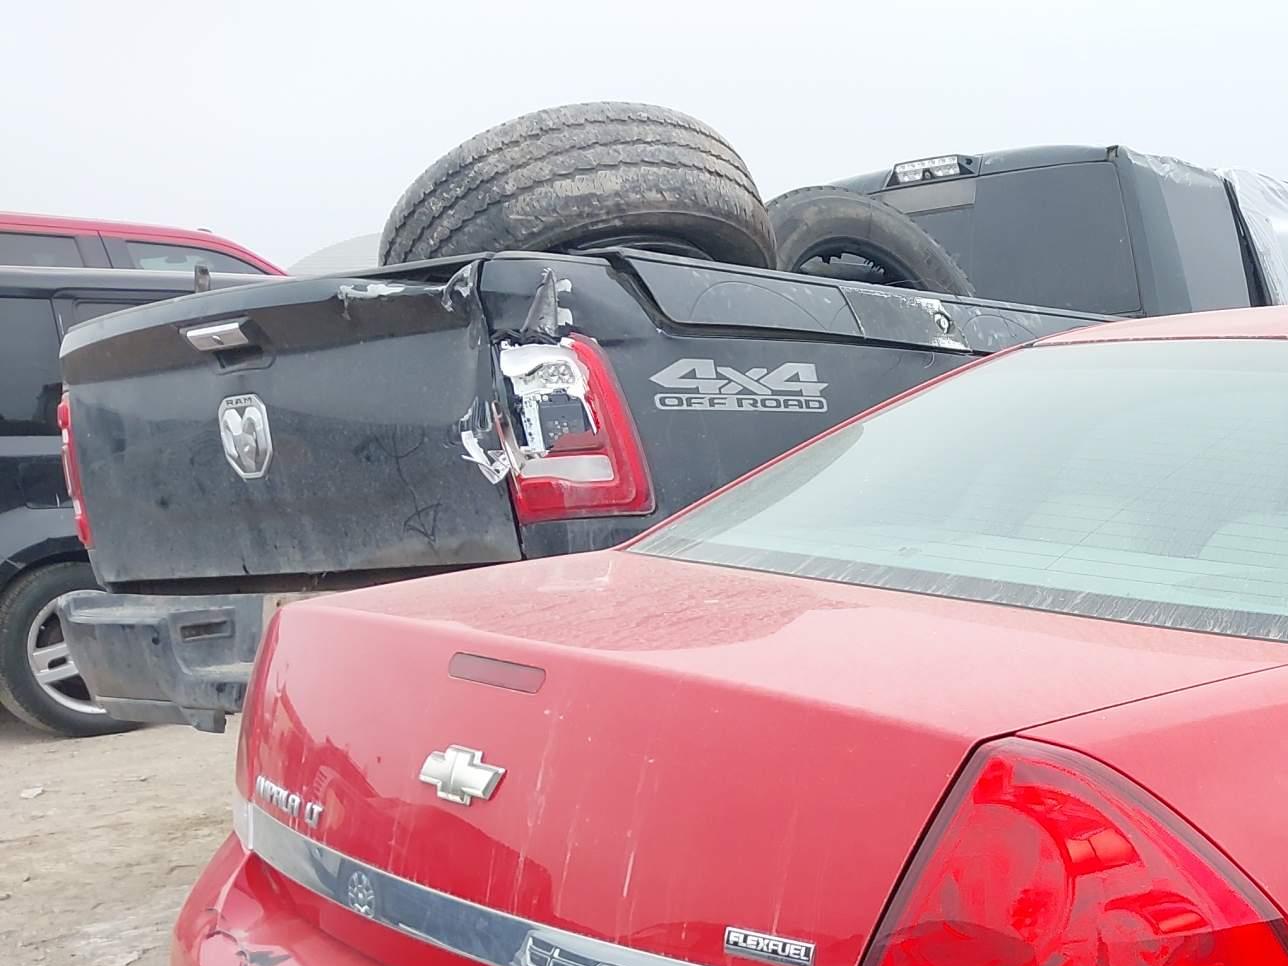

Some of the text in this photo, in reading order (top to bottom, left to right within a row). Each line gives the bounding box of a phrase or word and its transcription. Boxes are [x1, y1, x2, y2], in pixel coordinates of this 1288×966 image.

[225, 396, 253, 406] RAM
[658, 395, 826, 411] OFF ROAD
[304, 801, 325, 829] LT
[728, 930, 811, 961] FLEXFUEL
